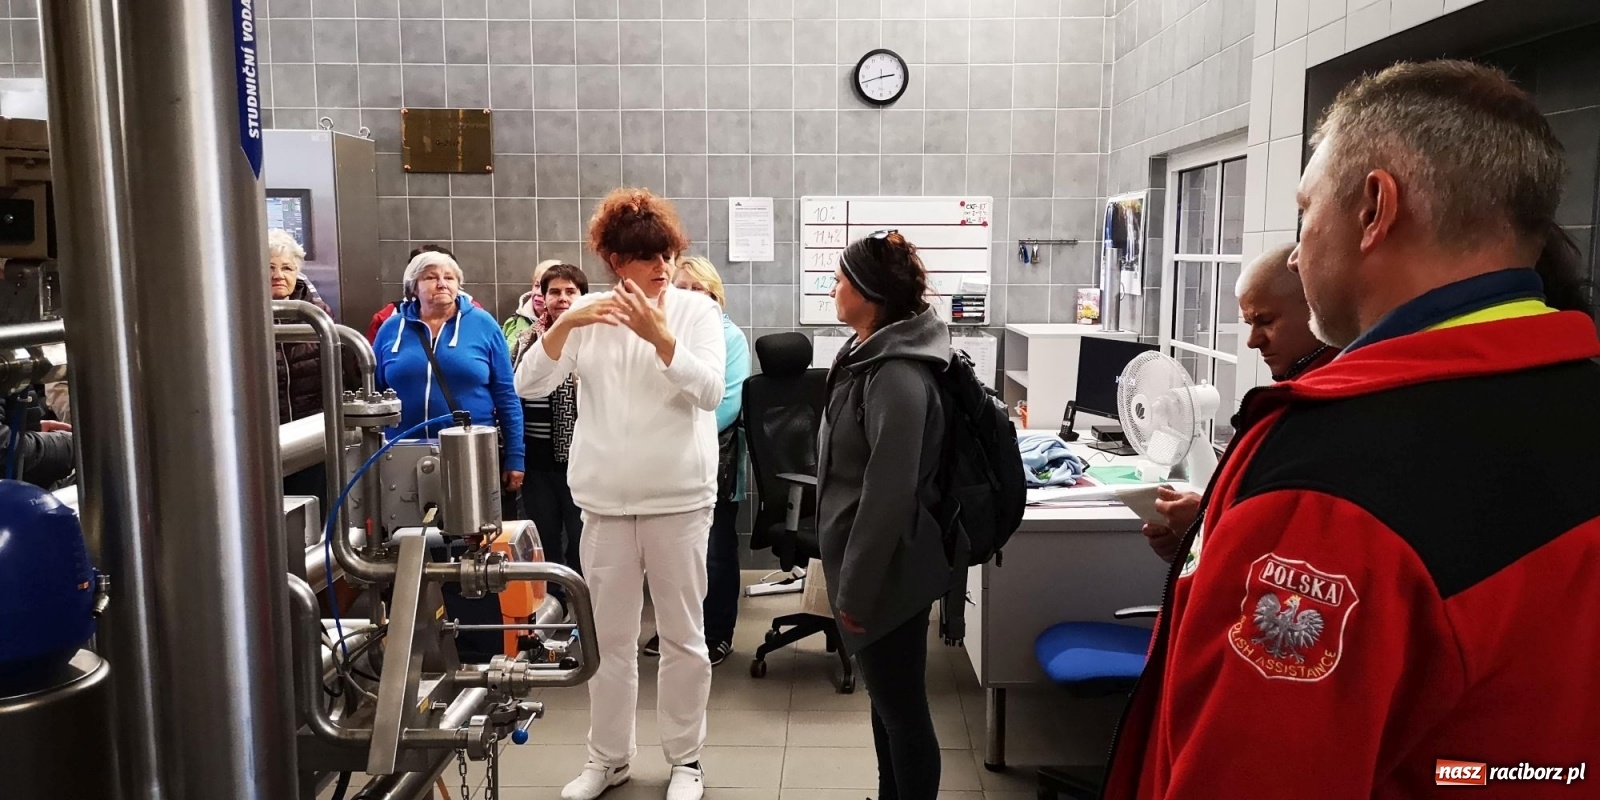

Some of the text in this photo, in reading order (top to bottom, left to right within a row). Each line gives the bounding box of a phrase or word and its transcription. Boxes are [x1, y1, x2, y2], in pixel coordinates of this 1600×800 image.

[241, 0, 260, 139] STUDNIČNÍ VODA
[1262, 561, 1337, 604] POLSKA
[1255, 649, 1337, 678] ASSISTANCE
